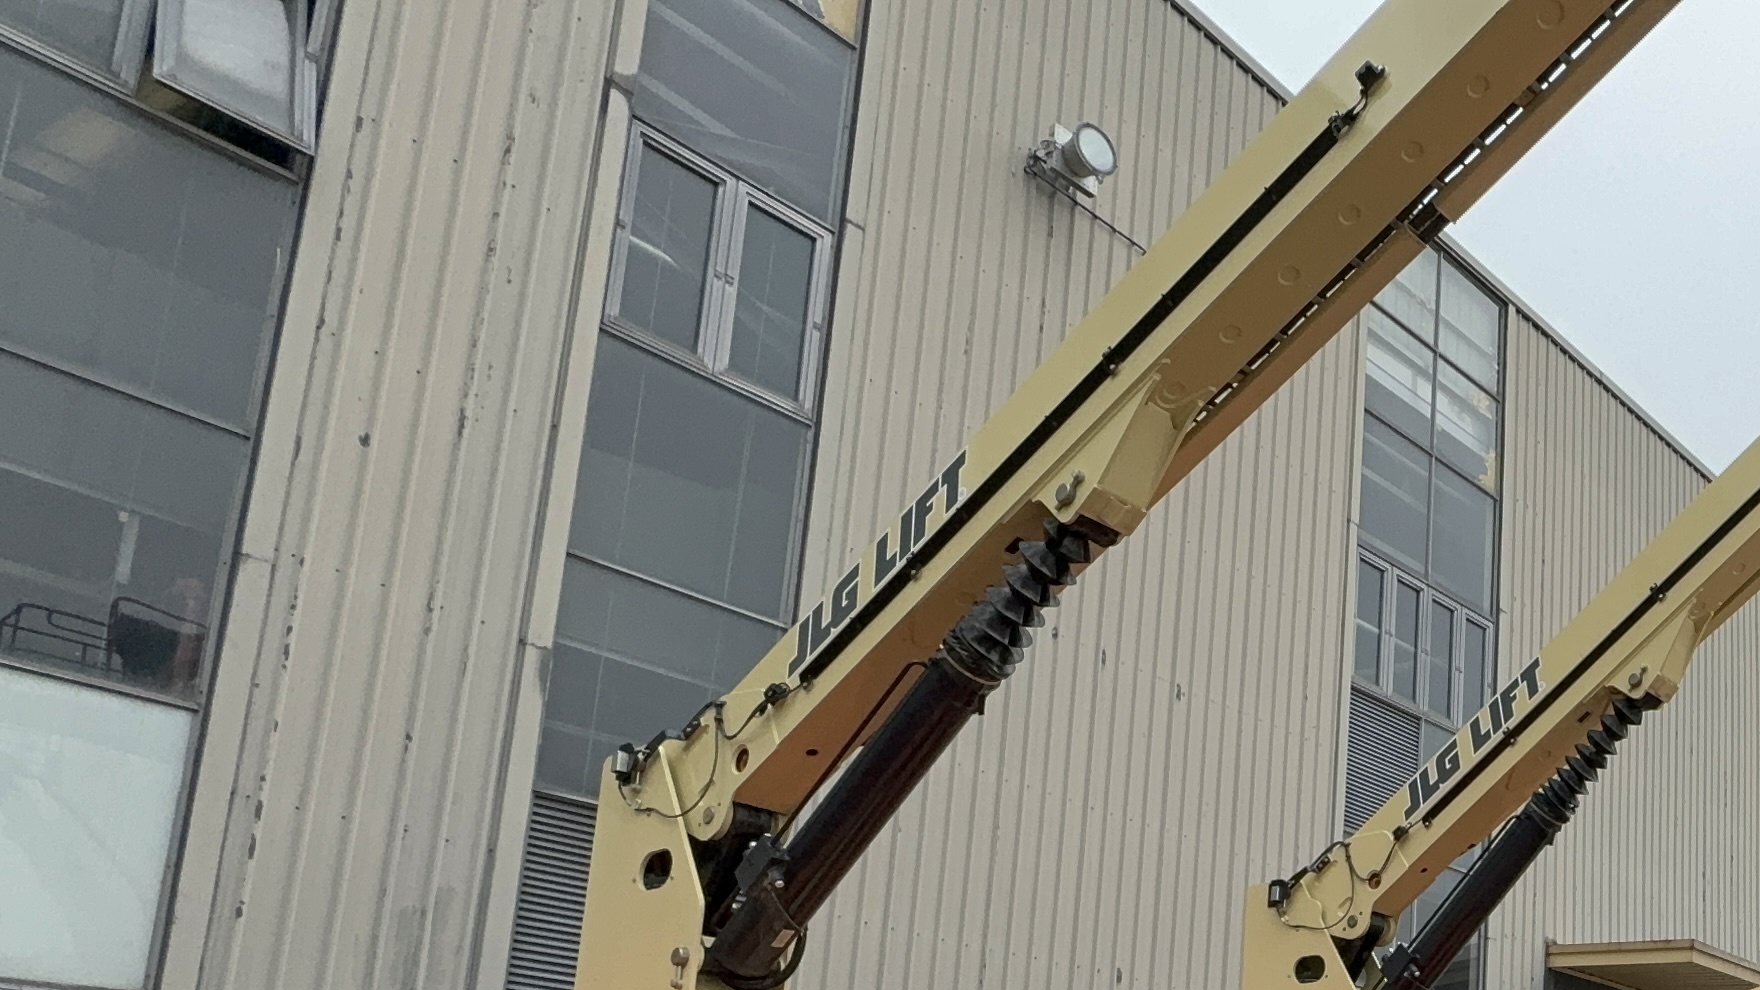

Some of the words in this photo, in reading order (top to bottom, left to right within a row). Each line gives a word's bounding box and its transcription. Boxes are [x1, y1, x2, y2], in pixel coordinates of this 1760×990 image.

[787, 560, 861, 679] JLG
[872, 448, 967, 592] LIFT
[1402, 738, 1461, 821] JLG
[1468, 656, 1541, 755] LIFT
